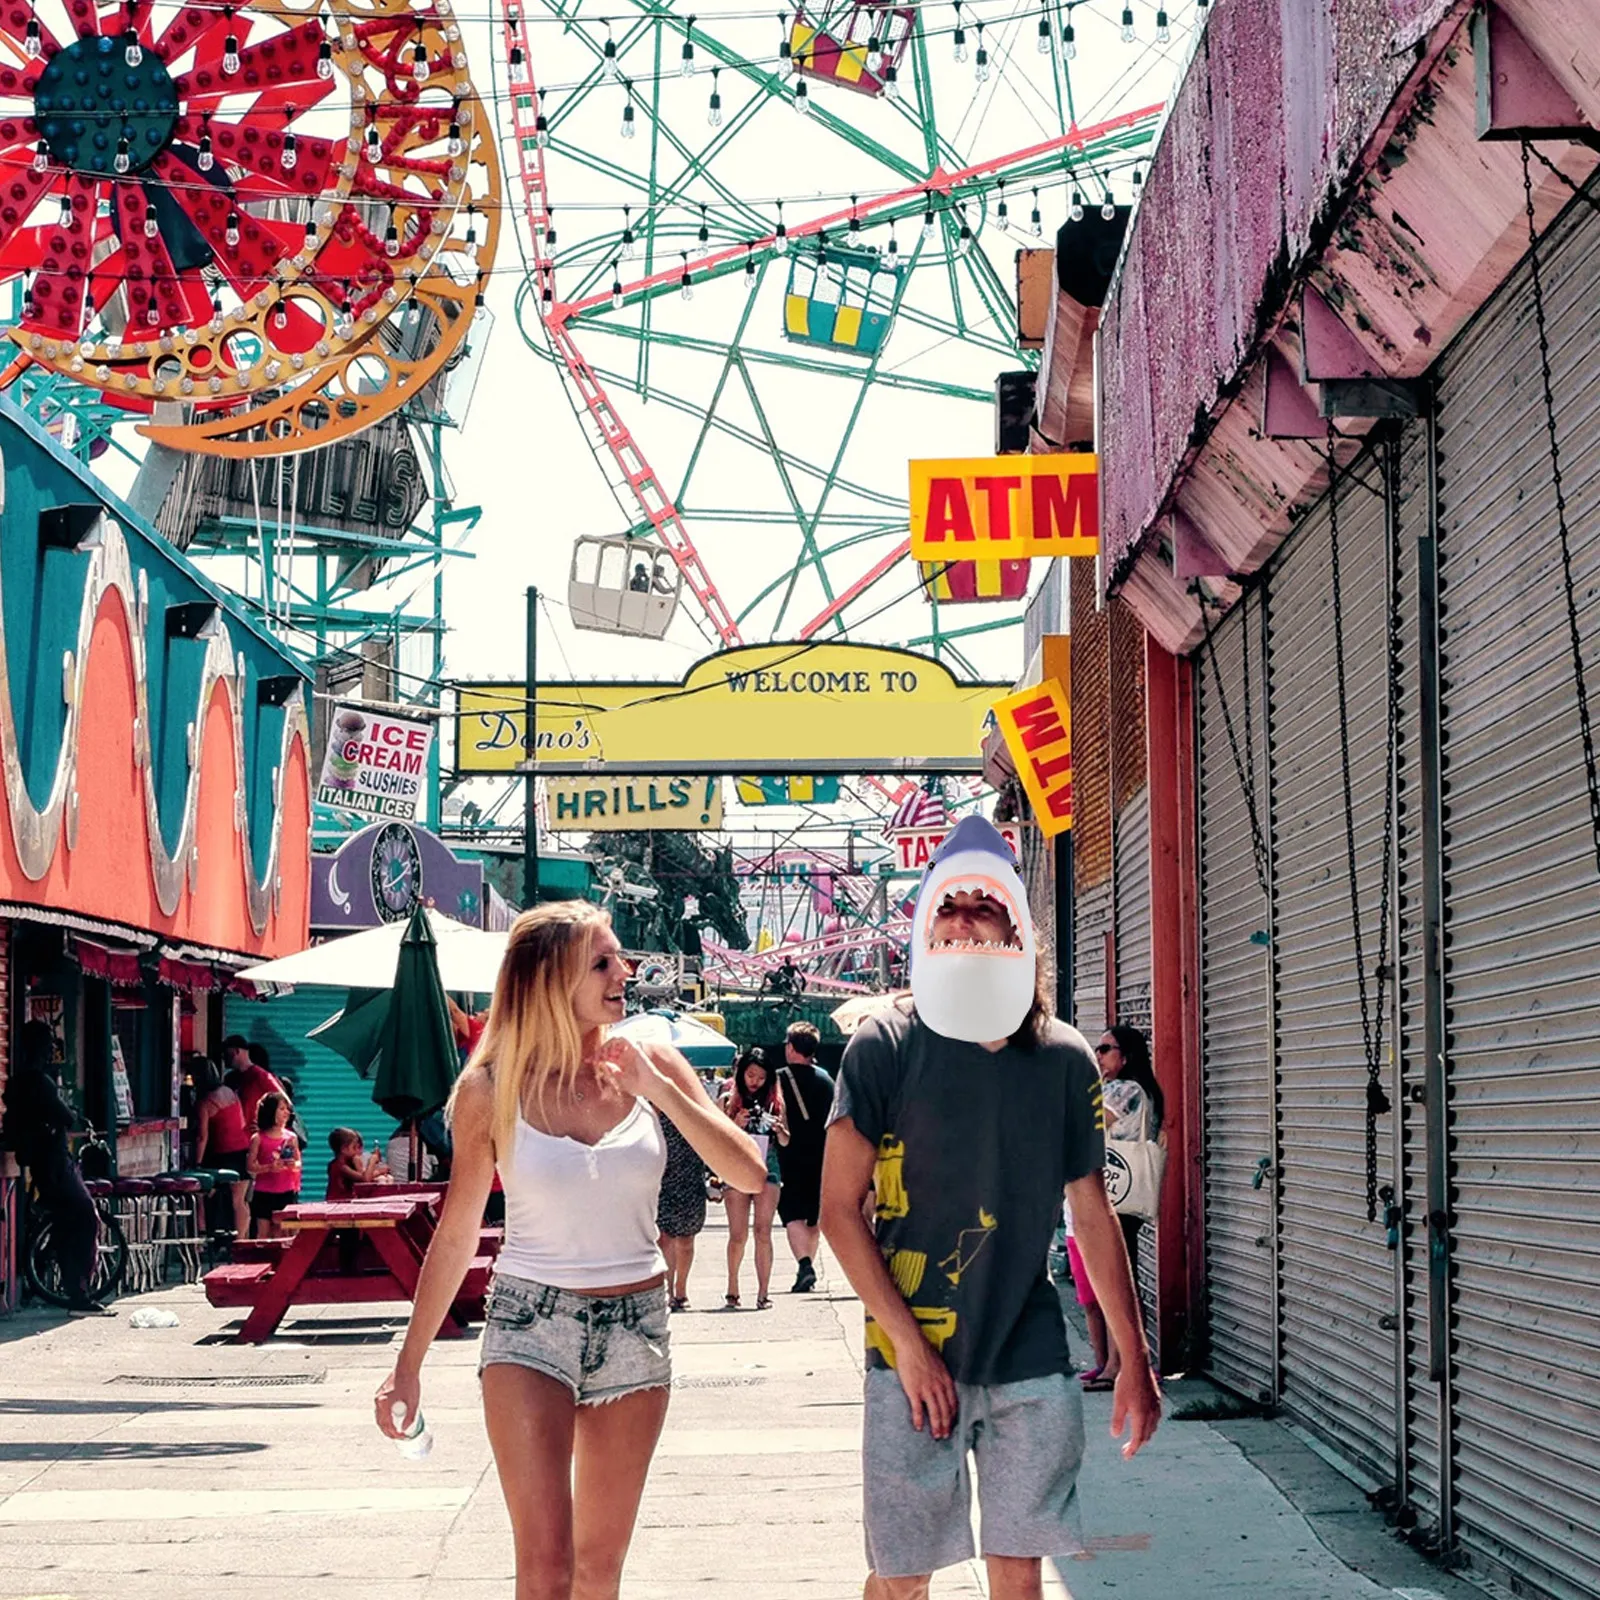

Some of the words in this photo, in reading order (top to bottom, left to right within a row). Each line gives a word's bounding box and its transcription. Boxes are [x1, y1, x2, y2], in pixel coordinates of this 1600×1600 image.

[923, 473, 1098, 543] ATM
[724, 670, 871, 693] WELCOME
[881, 670, 918, 693] TO
[370, 723, 428, 751] ICE
[343, 741, 423, 775] CREAM
[359, 770, 418, 795] SLUSHIES
[320, 786, 377, 812] ITALIAN
[379, 798, 413, 818] ICES
[547, 776, 715, 824] HRILLS!
